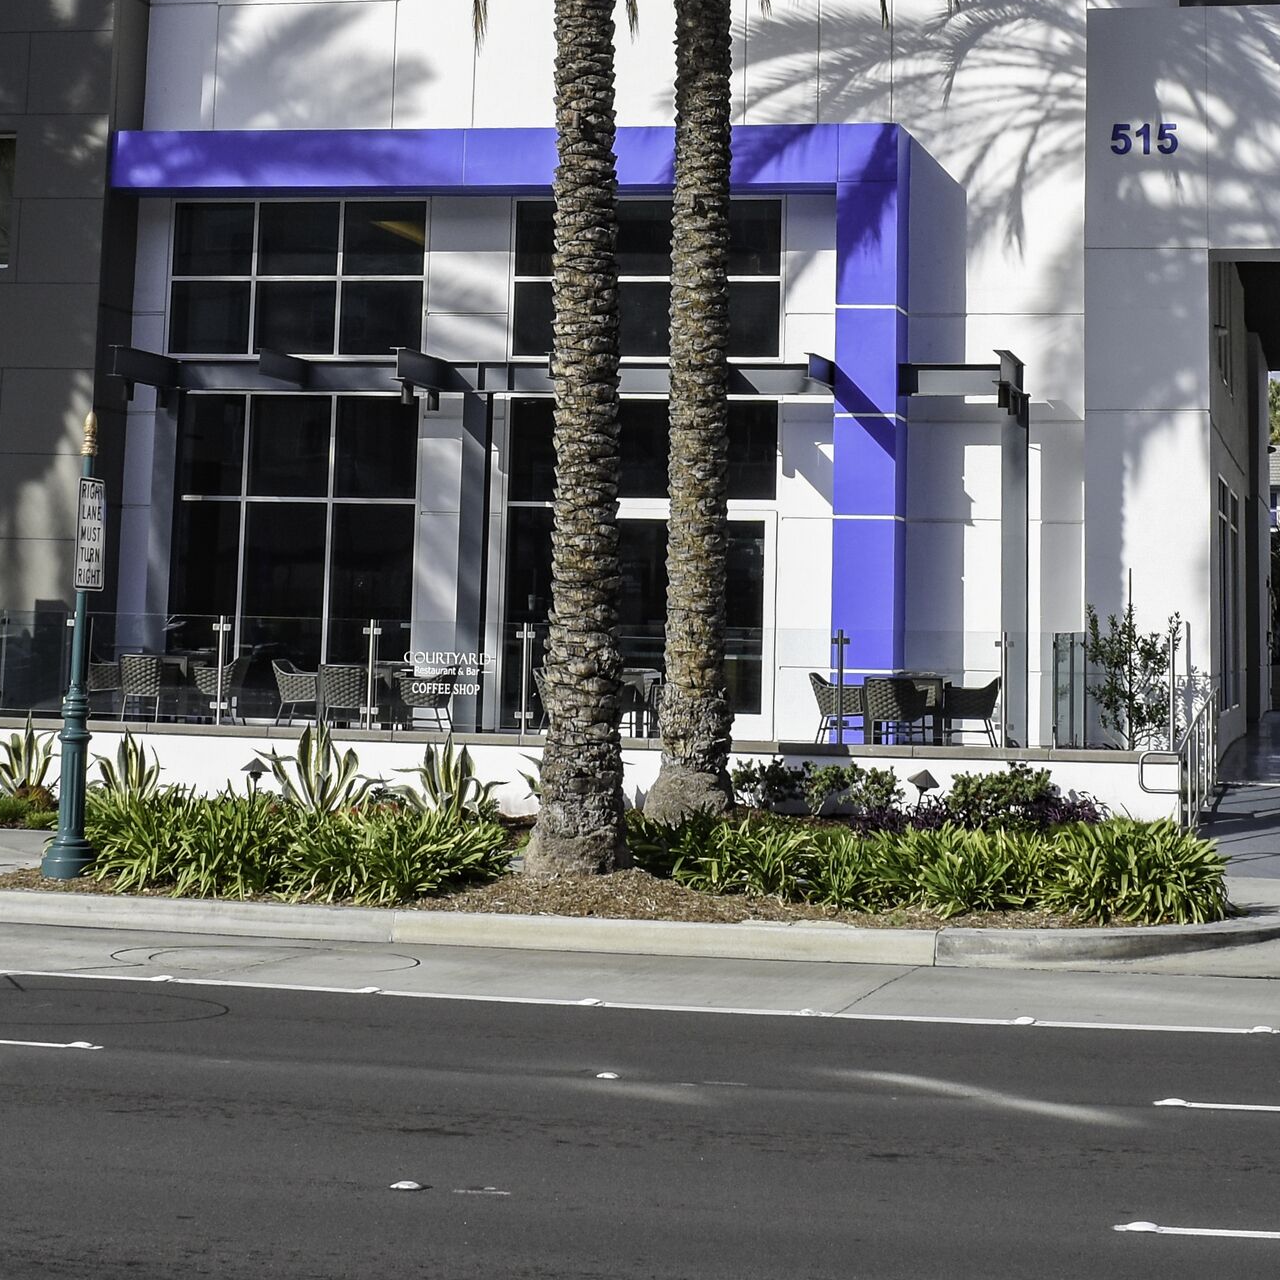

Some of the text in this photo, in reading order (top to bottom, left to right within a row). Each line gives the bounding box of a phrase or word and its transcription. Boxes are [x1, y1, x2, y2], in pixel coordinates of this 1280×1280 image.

[1111, 123, 1178, 155] 515
[82, 505, 102, 522] LANE
[80, 526, 101, 542] MUST
[80, 546, 100, 563] TURN
[77, 568, 101, 585] RIGHT
[403, 651, 491, 665] COURTYARD
[414, 666, 480, 676] Restaurant & Bar
[412, 682, 481, 696] COFFEE SHOP
